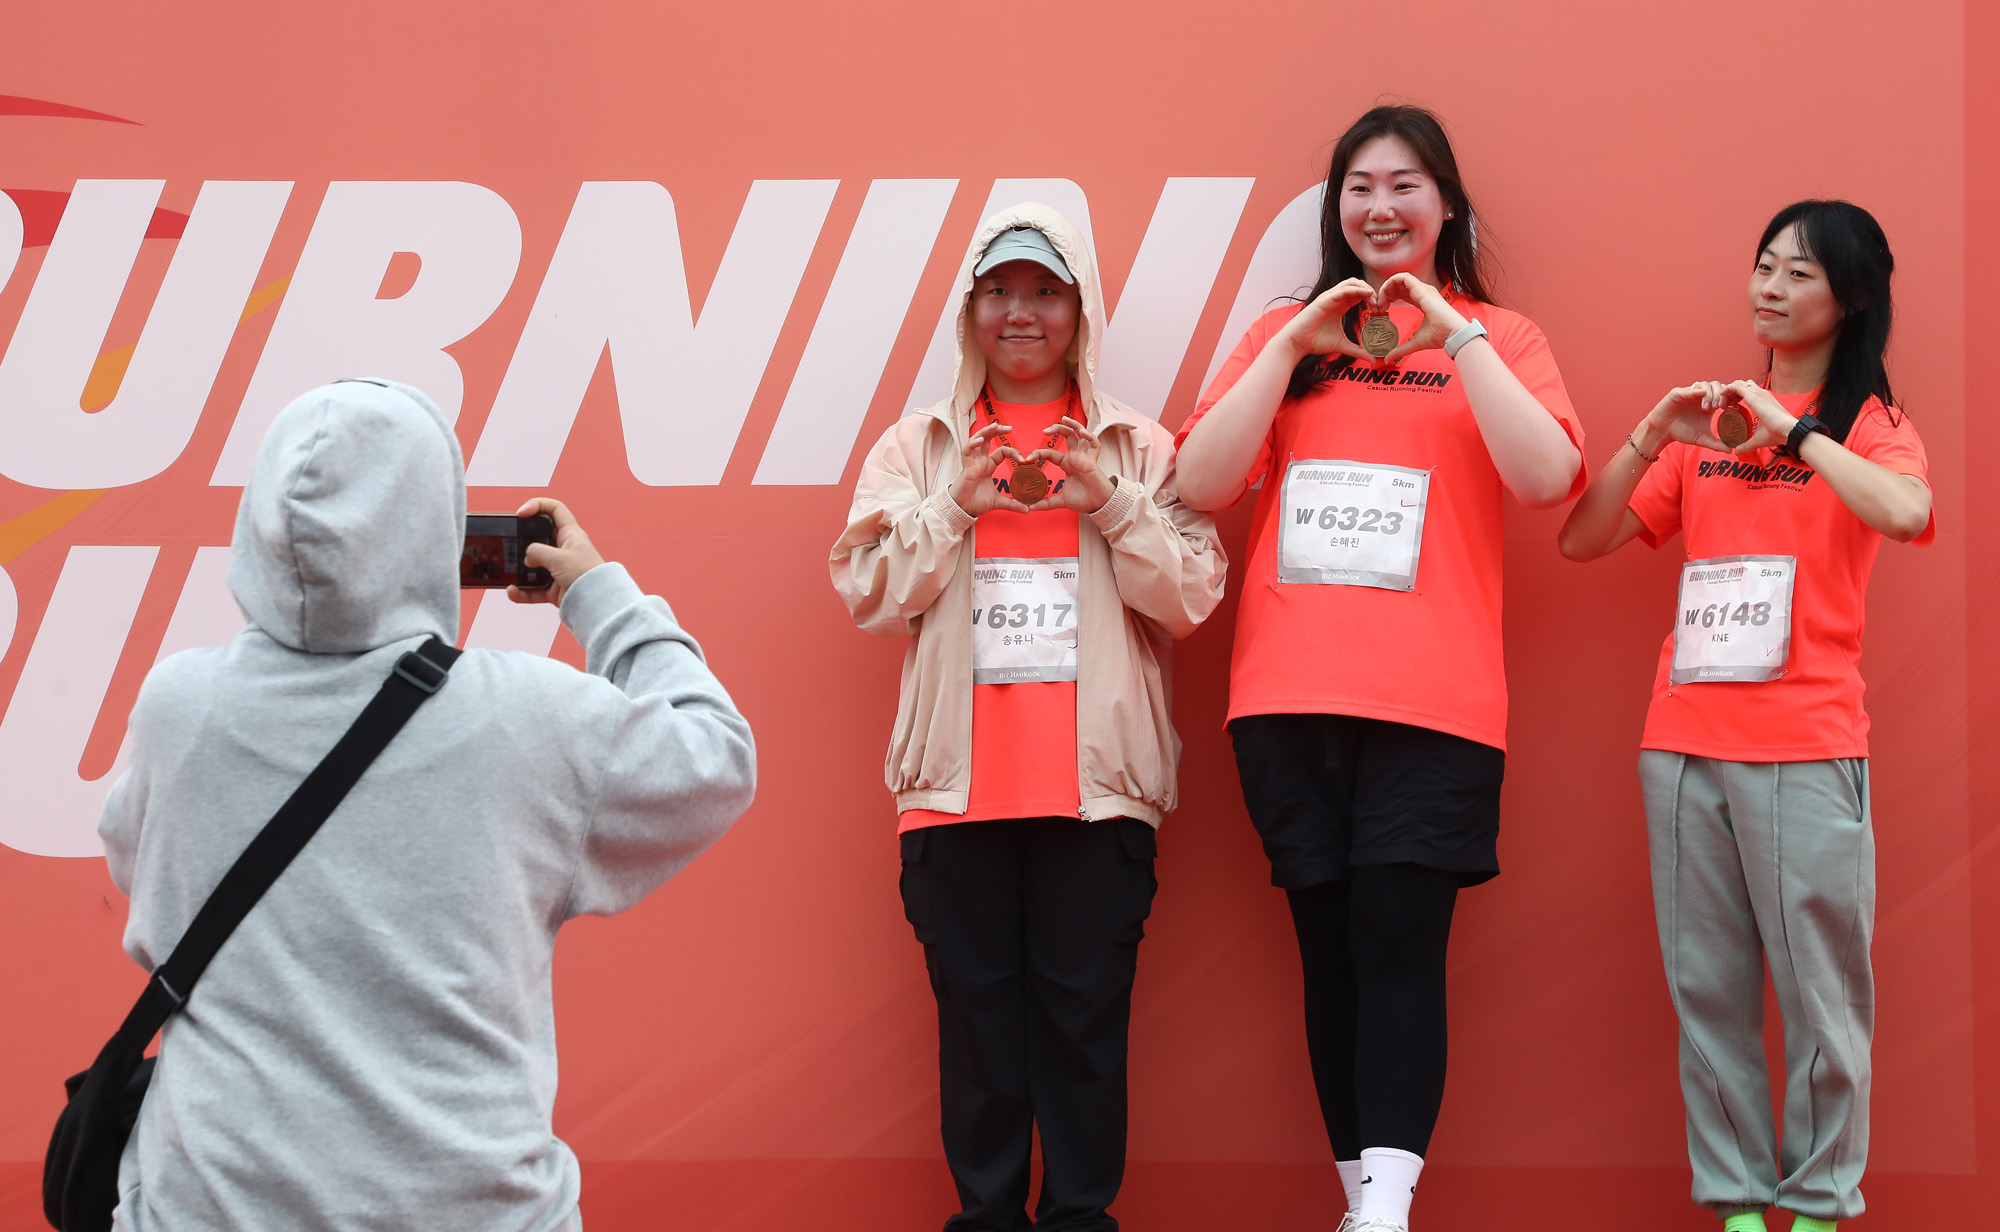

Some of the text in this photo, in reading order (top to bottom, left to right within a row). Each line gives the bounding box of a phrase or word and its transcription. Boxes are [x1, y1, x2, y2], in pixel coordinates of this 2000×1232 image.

[1400, 371, 1452, 387] RUN
[1296, 470, 1374, 484] BURNING RUN
[1770, 464, 1816, 486] RUN
[1391, 478, 1415, 489] 5km
[1296, 505, 1403, 535] W 6323
[1330, 537, 1360, 548] 손혜진
[1009, 569, 1035, 580] RUN
[1053, 570, 1076, 579] 5km
[1689, 567, 1744, 582] BURNING RUN
[1760, 569, 1782, 578] 5km
[987, 603, 1073, 629] 6317
[1685, 601, 1772, 629] W 6148
[1002, 633, 1035, 646] 송유나
[1711, 633, 1730, 643] KNE
